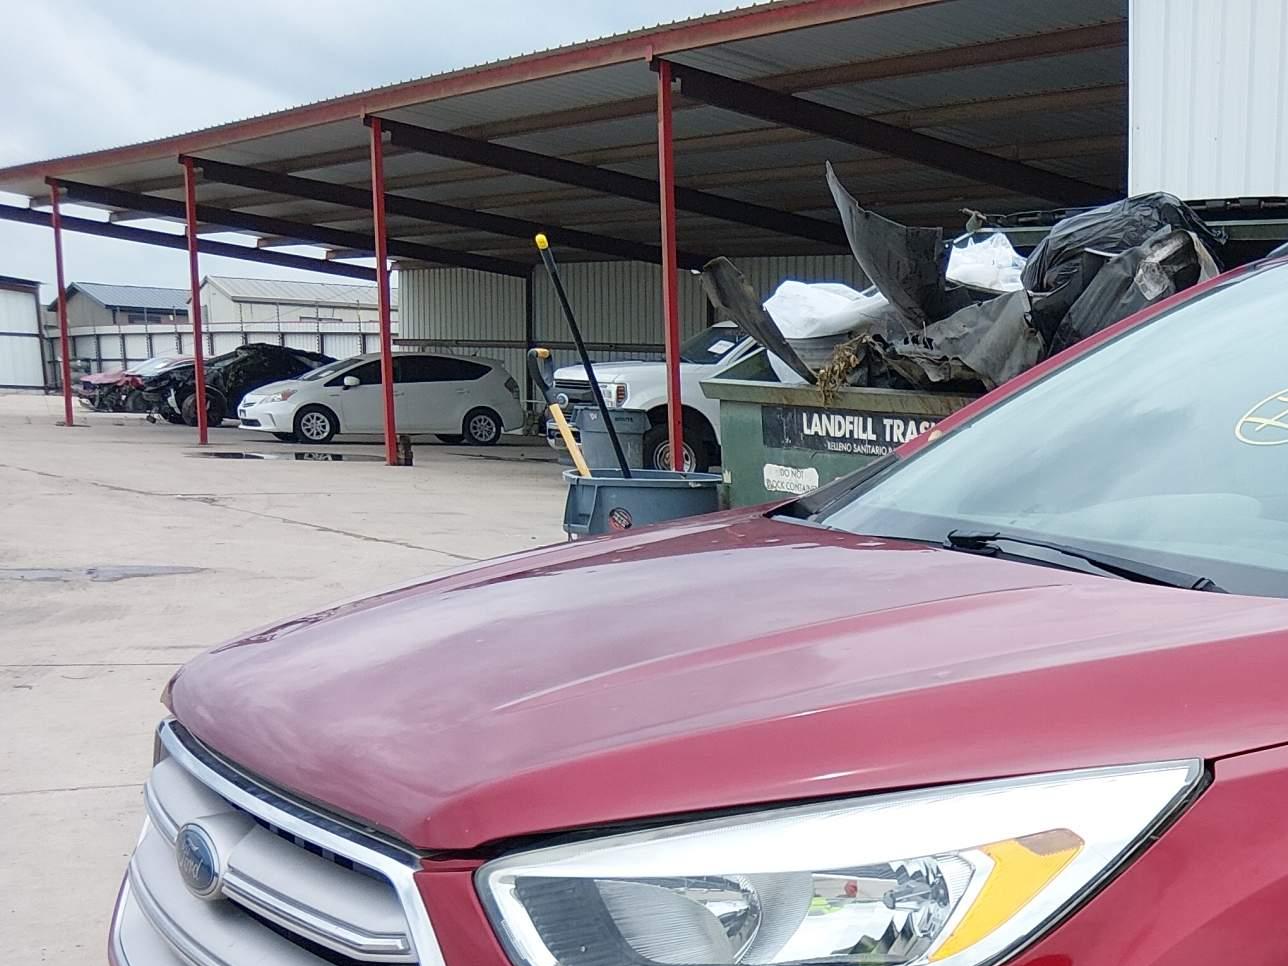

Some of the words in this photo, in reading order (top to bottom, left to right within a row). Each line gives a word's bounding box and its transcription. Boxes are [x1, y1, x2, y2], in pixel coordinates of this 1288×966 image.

[802, 412, 877, 442] LANDFILL
[883, 418, 937, 443] TRAS
[852, 444, 887, 456] SANITARIO
[791, 470, 804, 481] NOT
